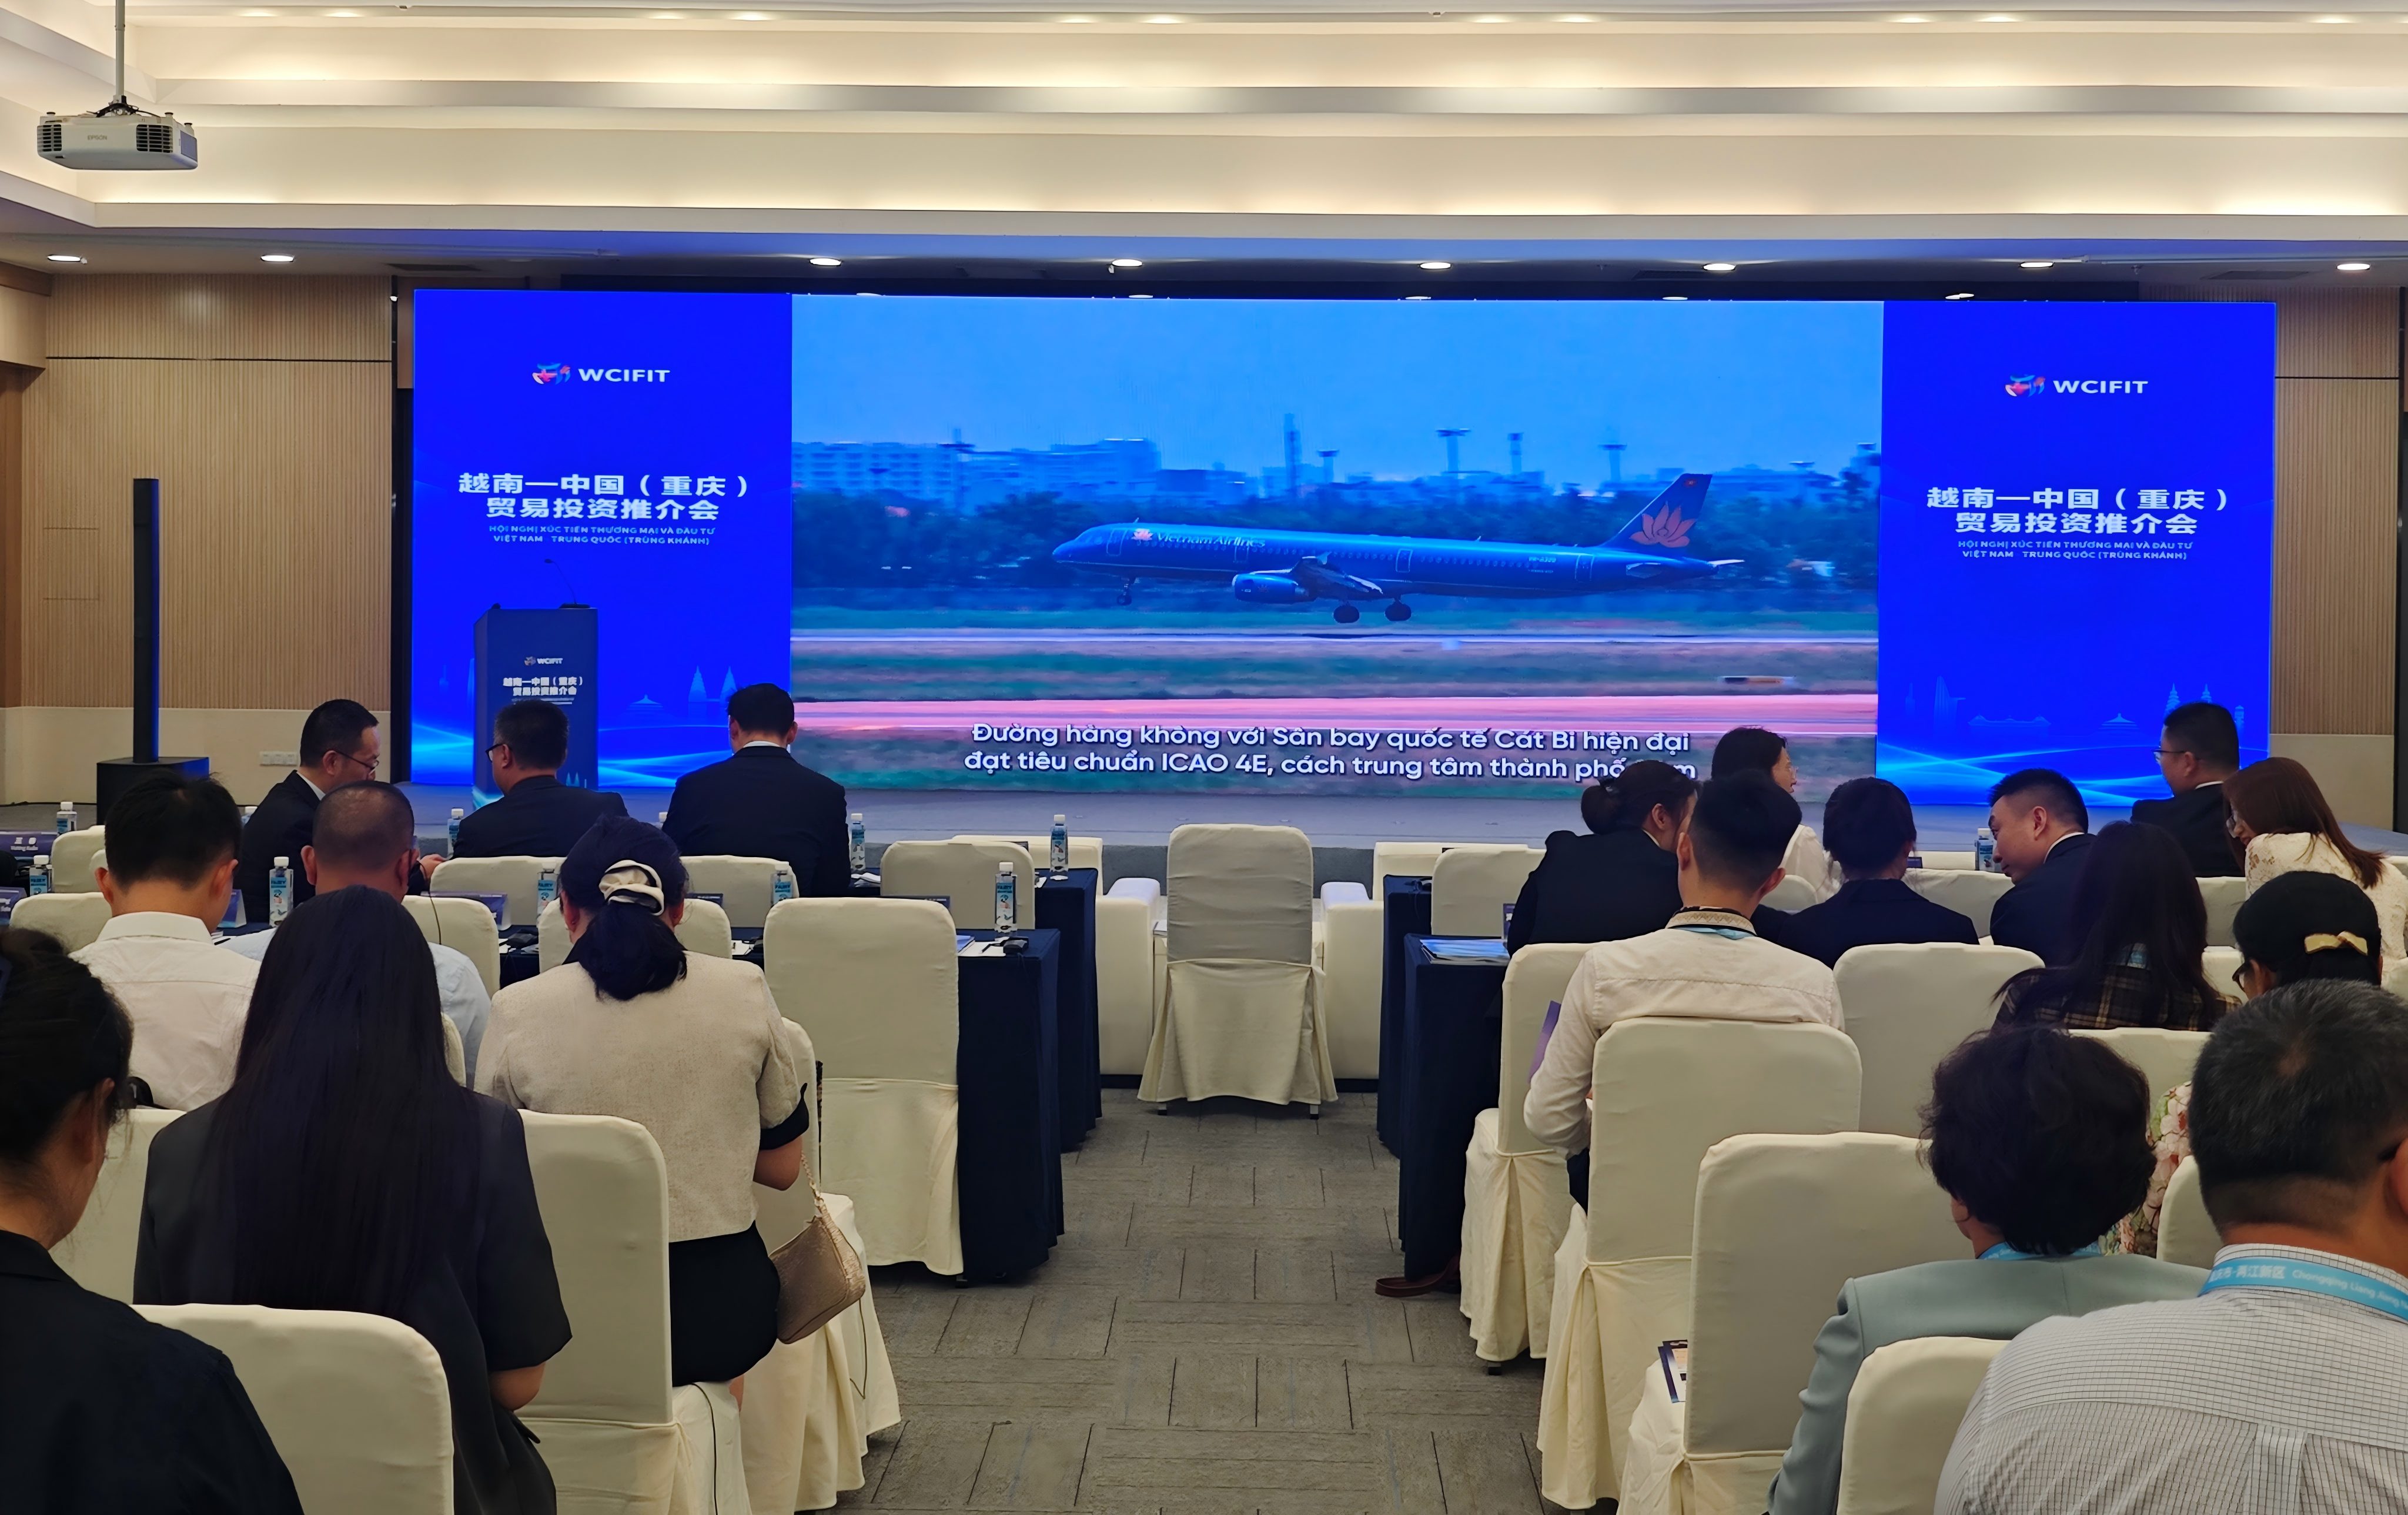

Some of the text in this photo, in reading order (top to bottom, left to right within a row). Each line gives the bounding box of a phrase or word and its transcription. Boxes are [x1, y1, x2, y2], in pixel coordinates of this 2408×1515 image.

[578, 368, 671, 383] WCIFIT
[2053, 380, 2149, 394] WCIFIT
[486, 497, 720, 520] 贸易投资推介会
[1955, 512, 2198, 535] 贸易投资推介会
[971, 723, 1689, 755] Đường hàng không với Sân bay quốc tế Cát Bi hiện đại
[964, 750, 1011, 774] đạt
[1017, 750, 1066, 770] tiêu
[1073, 749, 1155, 771] chuẩn
[1162, 753, 1229, 772] ICAO
[1235, 754, 1274, 776] 4E,
[1280, 754, 1345, 774] cách
[1352, 757, 1422, 780] trung
[1429, 757, 1482, 776] tâm
[1489, 757, 1567, 777] thành
[1575, 757, 1627, 782] phố
[2292, 1269, 2348, 1290] Chongqing
